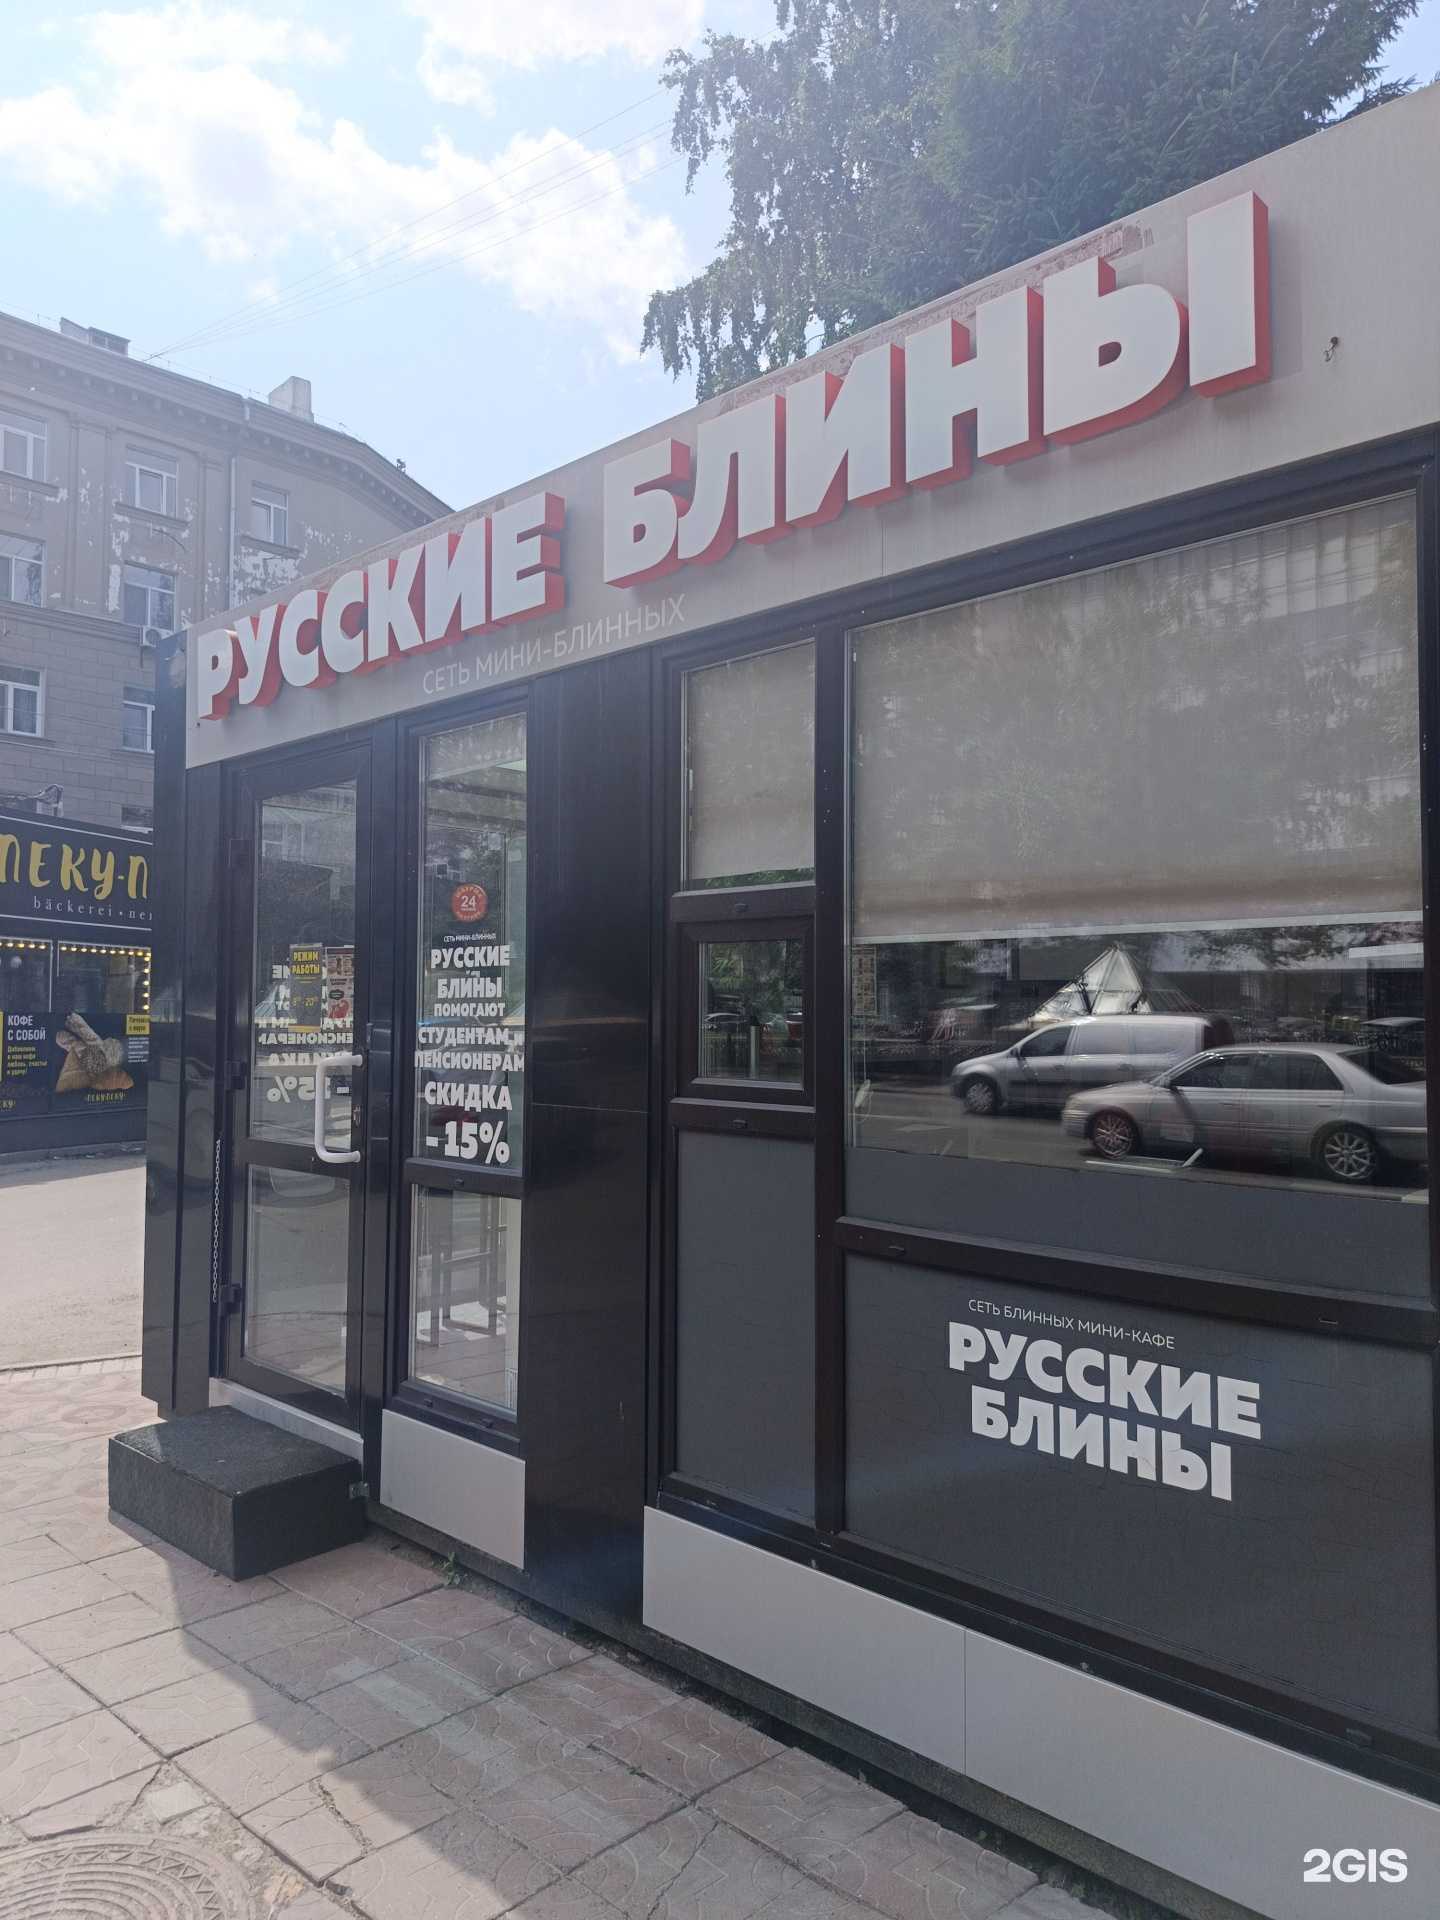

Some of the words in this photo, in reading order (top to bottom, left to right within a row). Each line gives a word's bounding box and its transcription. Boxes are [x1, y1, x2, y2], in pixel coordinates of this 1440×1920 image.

[196, 491, 566, 720] РУССКИЕ
[603, 190, 1270, 590] БЛИНЫ
[423, 662, 470, 694] СЕТЬ
[476, 593, 686, 681] МИНИ-БЛИННЫХ
[33, 896, 112, 916] bäckerei
[460, 895, 477, 908] 24
[293, 951, 319, 962] РЕЖИМ
[430, 944, 511, 969] РУССКИЕ
[292, 963, 320, 975] РАБОТЫ
[437, 976, 502, 999] БЛИНЫ
[7, 1015, 33, 1026] КОФЕ
[433, 1002, 506, 1018] ПОМОГАЮТ
[16, 1027, 46, 1041] СОБОЙ
[417, 1026, 510, 1047] СТУДЕНТАМ
[414, 1050, 525, 1072] ПЕНСИОНЕРАМ
[424, 1081, 513, 1112] СКИДКА
[425, 1120, 510, 1164] -15%
[968, 1299, 1000, 1316] СЕТЬ
[1004, 1305, 1074, 1330] БЛИННЫХ
[1078, 1320, 1175, 1350] МИНИ-КАФЕ
[949, 1321, 1261, 1440] РУССКИЕ
[971, 1384, 1232, 1501] БЛИНЫ
